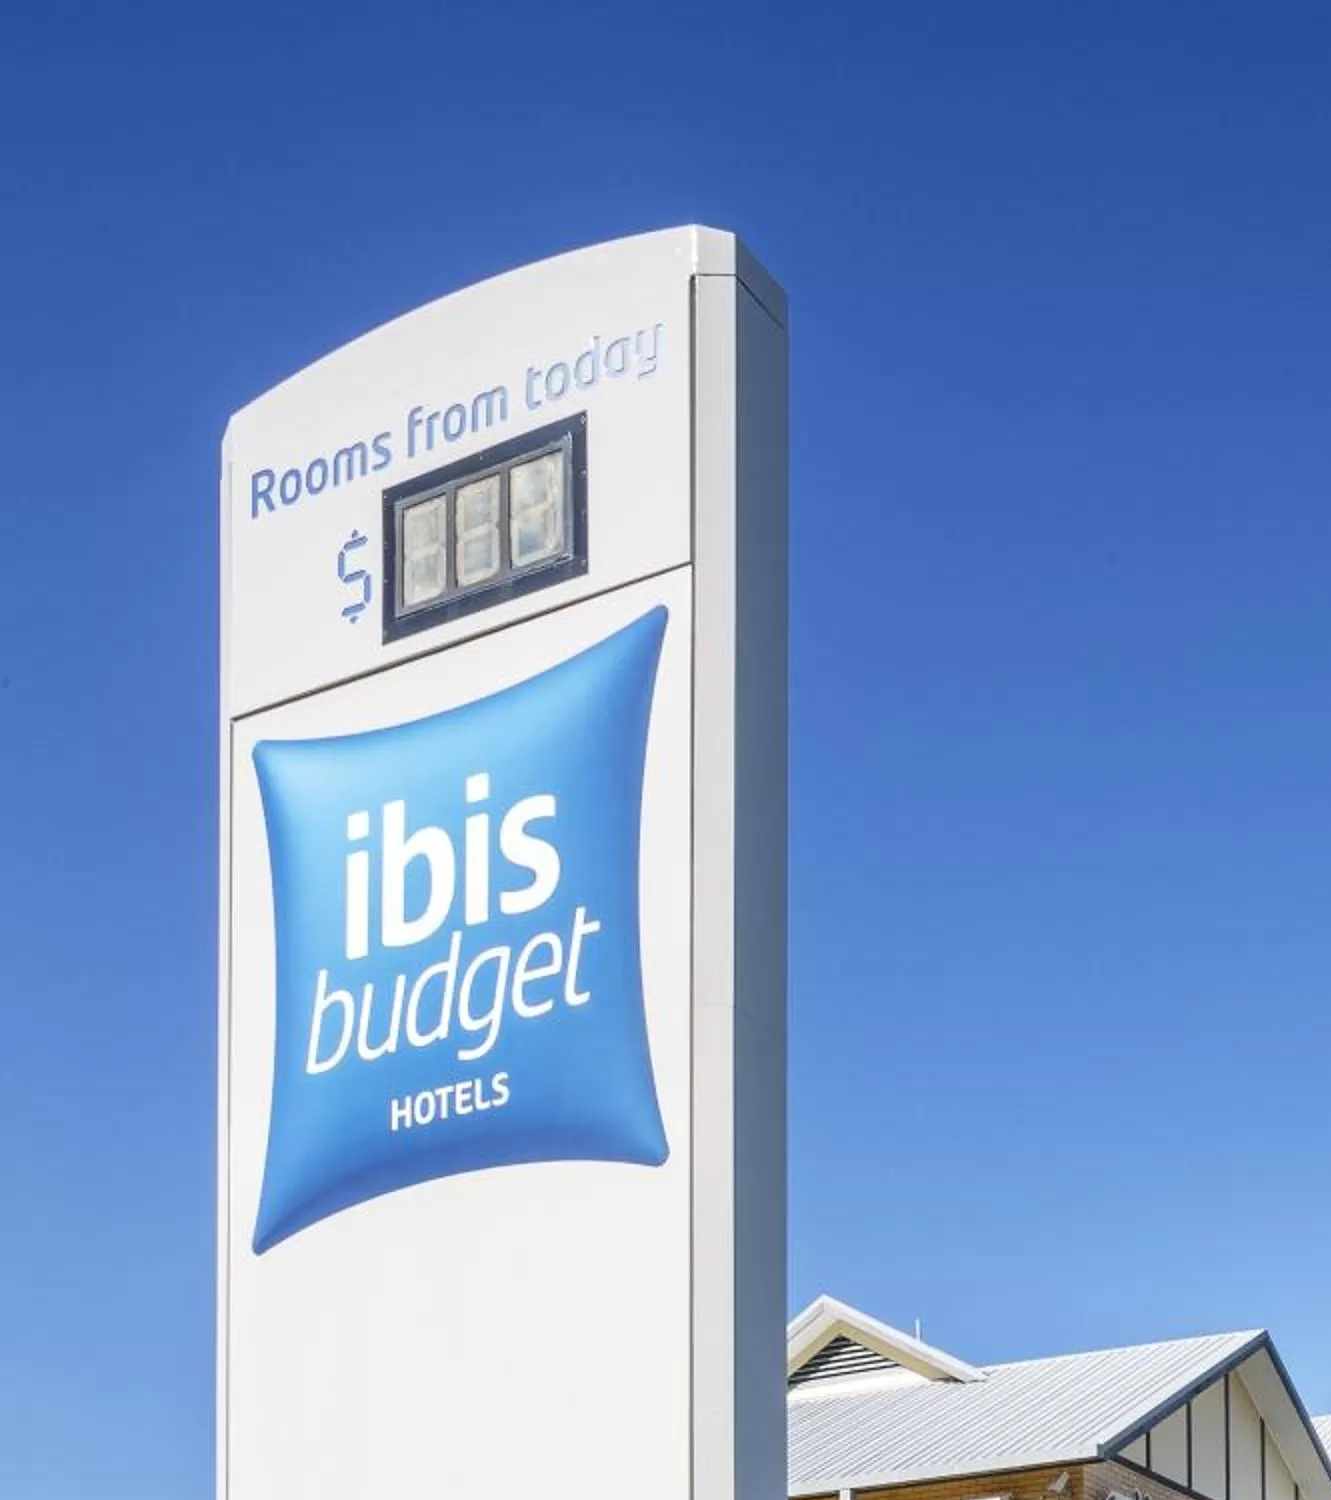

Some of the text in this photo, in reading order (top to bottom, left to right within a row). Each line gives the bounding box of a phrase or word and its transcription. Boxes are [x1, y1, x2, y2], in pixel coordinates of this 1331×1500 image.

[250, 323, 664, 519] Rooms from today
[337, 529, 372, 624] $
[345, 772, 561, 960] ibis
[306, 906, 600, 1075] budget
[391, 1072, 510, 1131] HOTELS
